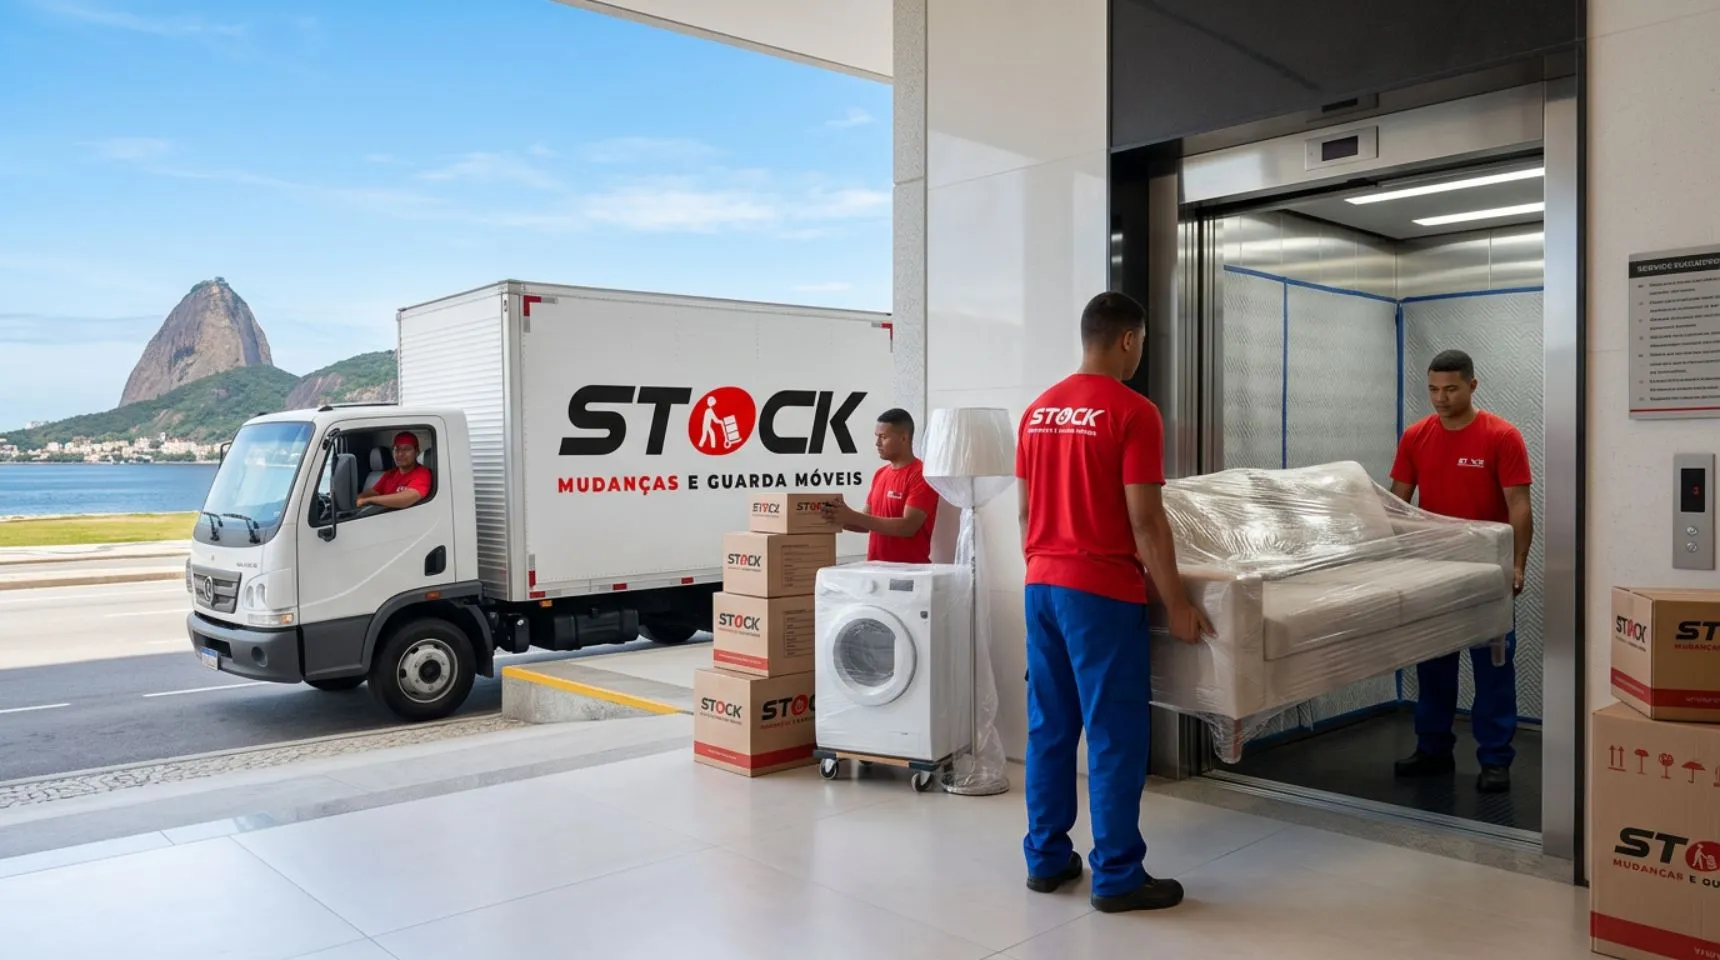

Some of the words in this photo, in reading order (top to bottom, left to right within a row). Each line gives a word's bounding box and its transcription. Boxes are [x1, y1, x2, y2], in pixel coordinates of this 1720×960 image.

[558, 384, 868, 456] STOCK
[1029, 407, 1105, 427] STOCK
[557, 475, 679, 495] MUDANÇAS
[688, 475, 699, 490] E
[707, 473, 787, 489] GUARDA
[795, 468, 863, 487] MÓVEIS
[727, 553, 762, 567] STOCK
[719, 613, 760, 631] STOCK
[701, 697, 742, 718] STOCK
[1689, 874, 1696, 884] E
